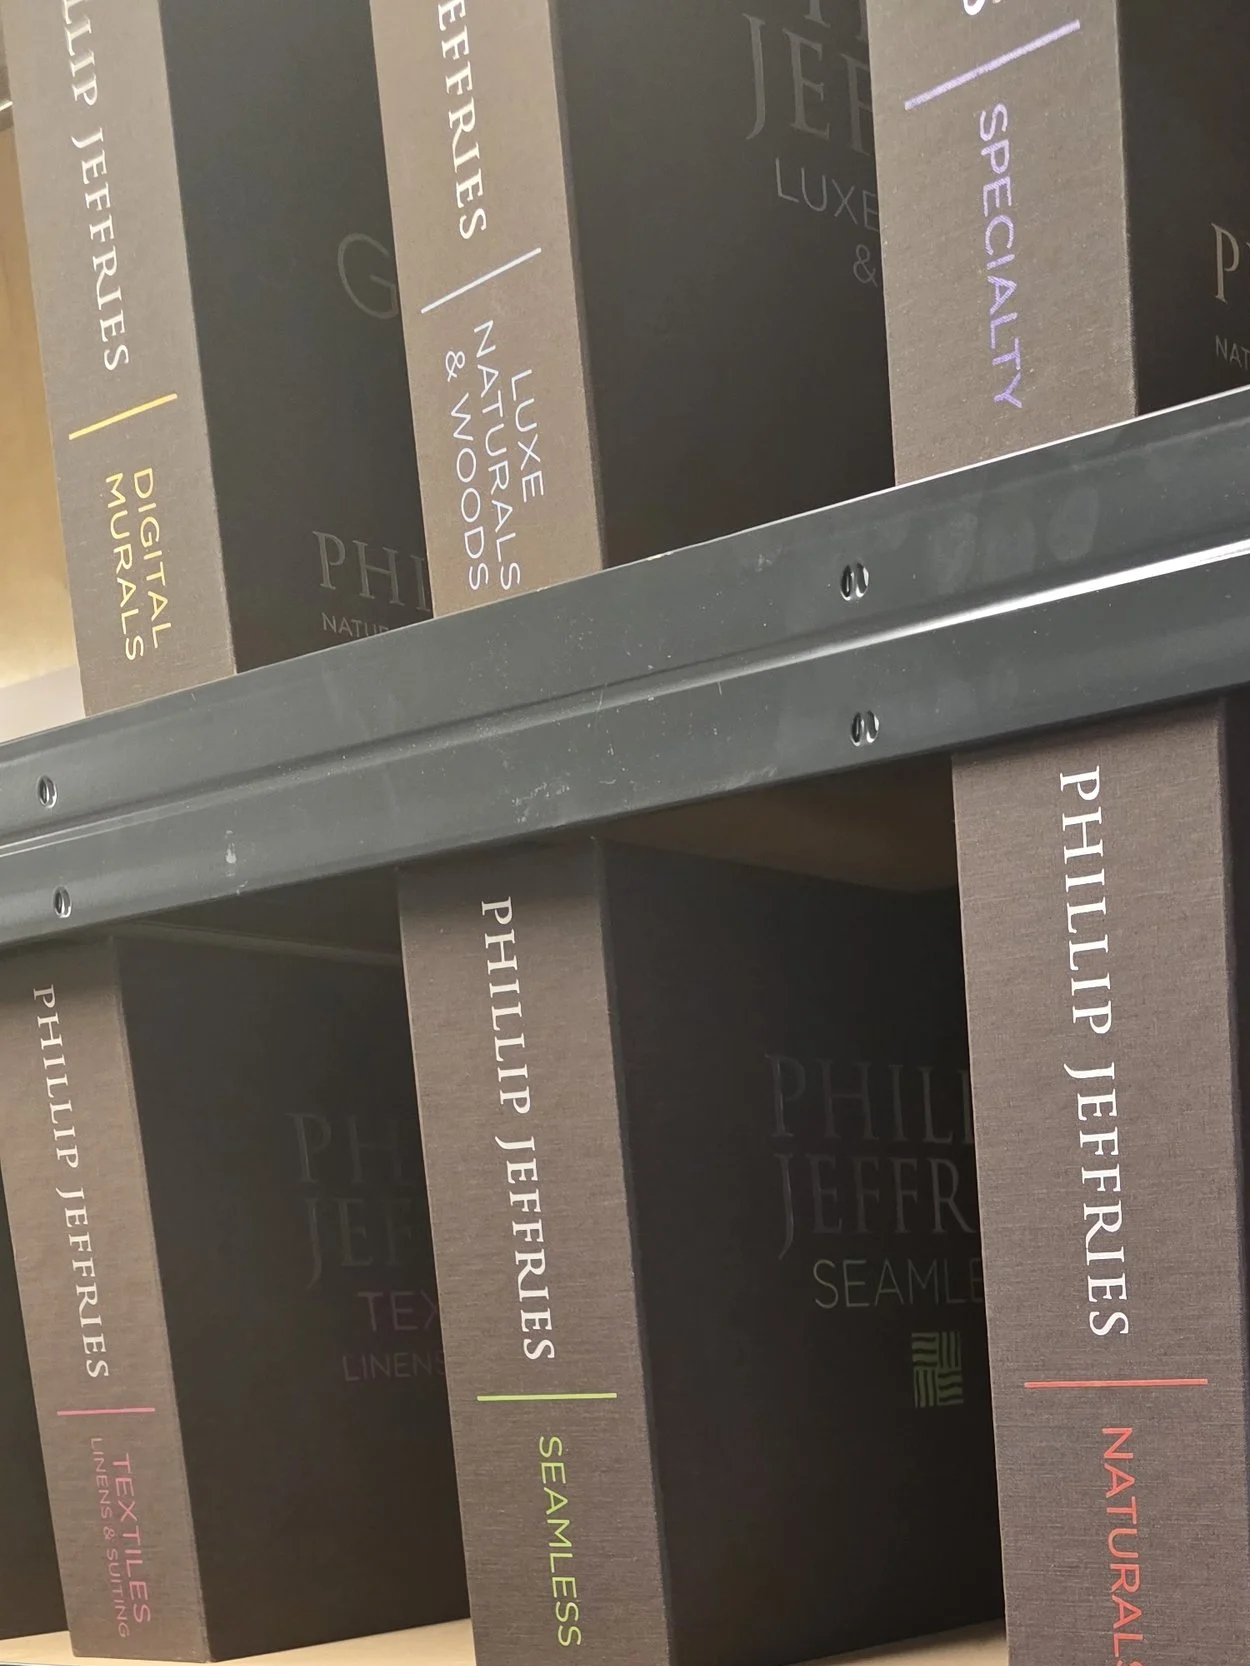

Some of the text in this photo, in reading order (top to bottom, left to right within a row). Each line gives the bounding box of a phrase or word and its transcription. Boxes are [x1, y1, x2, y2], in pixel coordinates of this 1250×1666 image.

[71, 127, 130, 372] JEFFRIES
[774, 157, 880, 234] LUXE
[978, 103, 1023, 410] SPECIALTY
[444, 349, 488, 591] & WOODS
[473, 318, 520, 591] NATURALS
[511, 369, 545, 504] LUXE
[105, 471, 144, 662] MURALS
[133, 467, 177, 650] DIGITAL
[311, 530, 432, 613] PHI
[321, 611, 390, 639] NAT
[479, 896, 556, 1362] PHILLIP JEFFRIES
[1058, 764, 1130, 1338] PHILLIP JEFFRIES
[32, 983, 110, 1380] PHILLIP JEFFRIES
[773, 1152, 977, 1260] JEFFR
[90, 1437, 130, 1638] LINENS & SUITING
[112, 1452, 151, 1623] TEXTILES
[539, 1435, 582, 1648] SEAMLESS
